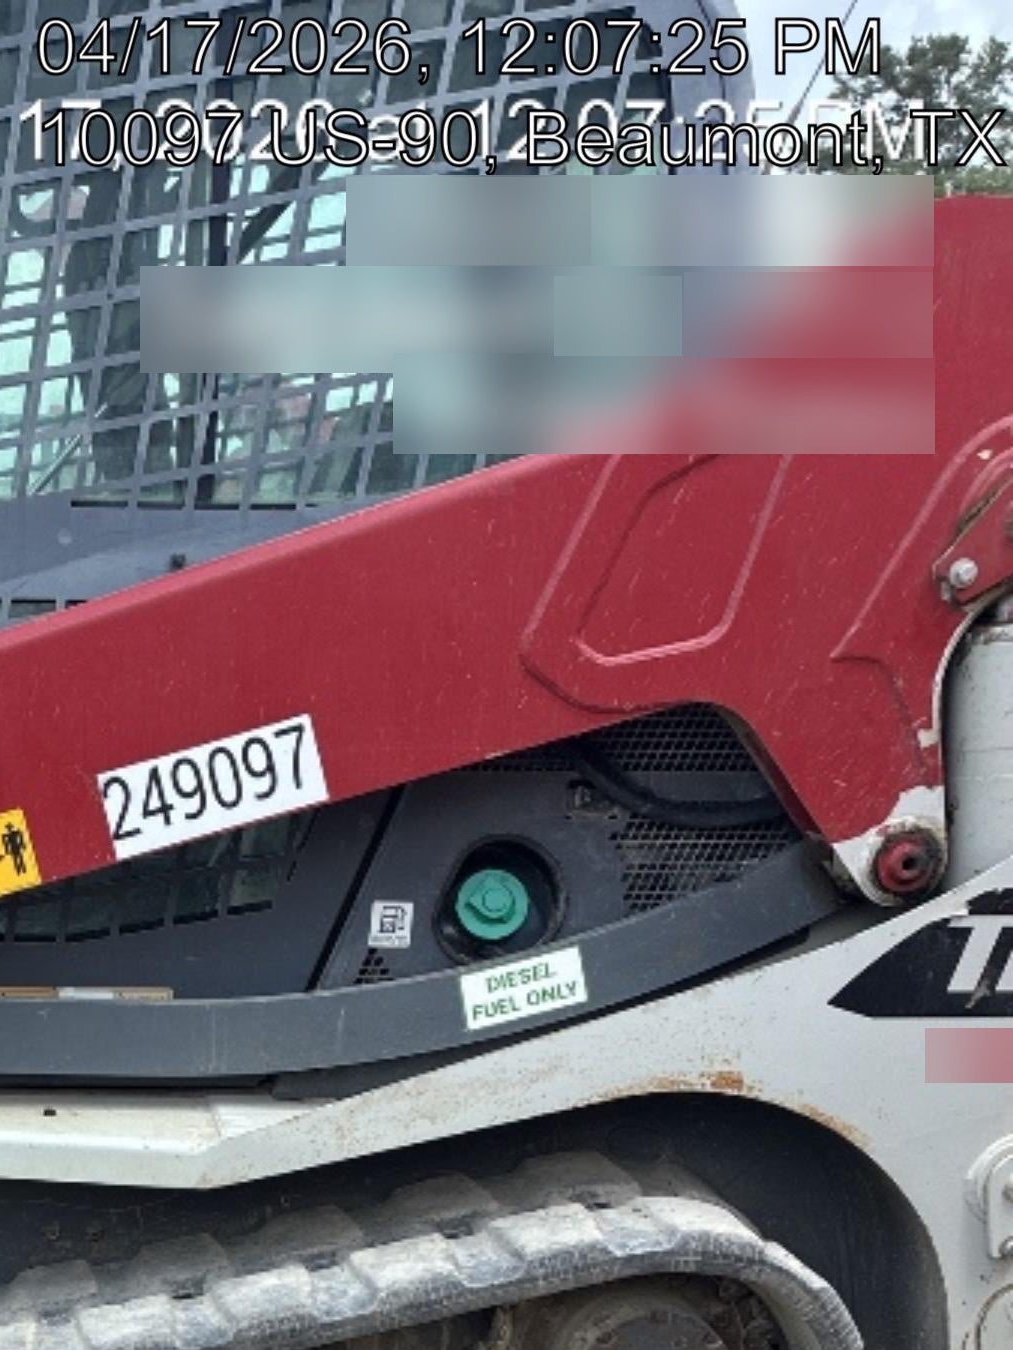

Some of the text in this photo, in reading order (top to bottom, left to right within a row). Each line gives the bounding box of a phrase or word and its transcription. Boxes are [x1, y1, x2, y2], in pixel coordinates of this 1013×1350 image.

[103, 723, 305, 840] 249097
[486, 962, 558, 993] DIESEL
[947, 914, 1013, 993] T
[472, 981, 577, 1021] FUEL ONLY
